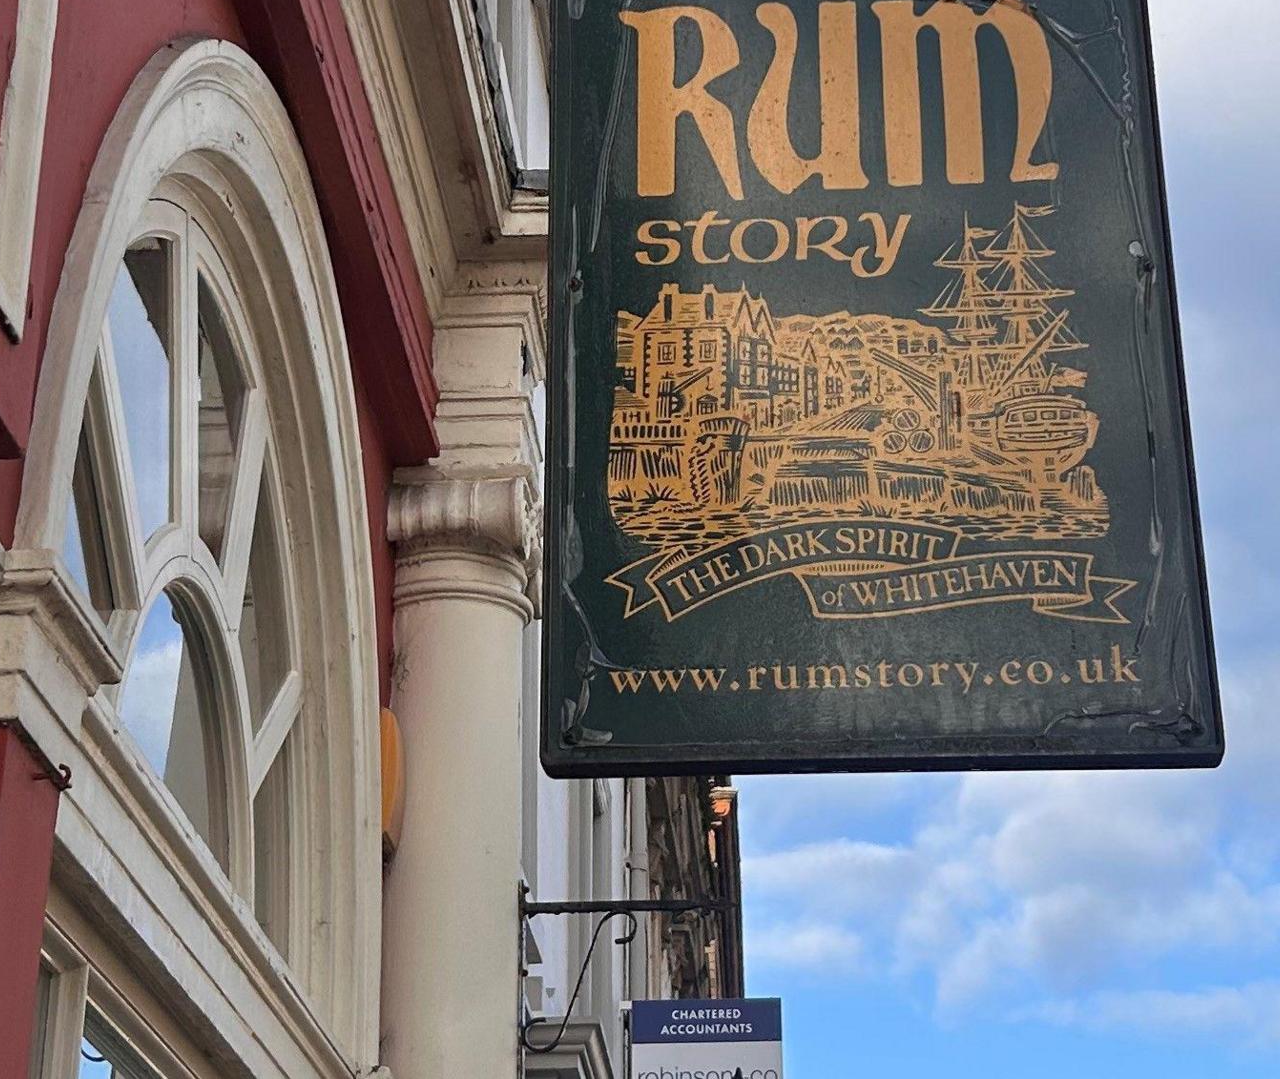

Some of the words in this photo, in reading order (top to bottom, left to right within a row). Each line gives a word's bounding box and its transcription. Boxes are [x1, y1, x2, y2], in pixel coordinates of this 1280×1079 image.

[666, 552, 740, 603] THE
[737, 528, 832, 573] DARK
[836, 528, 944, 561] SPIRIT
[822, 581, 846, 607] of
[849, 559, 1078, 607] WHITEHAVEN
[609, 643, 1141, 694] www.rumstory.co.uk
[660, 1023, 753, 1035] ACCOUNTANTS
[671, 1008, 741, 1020] CHARTERED
